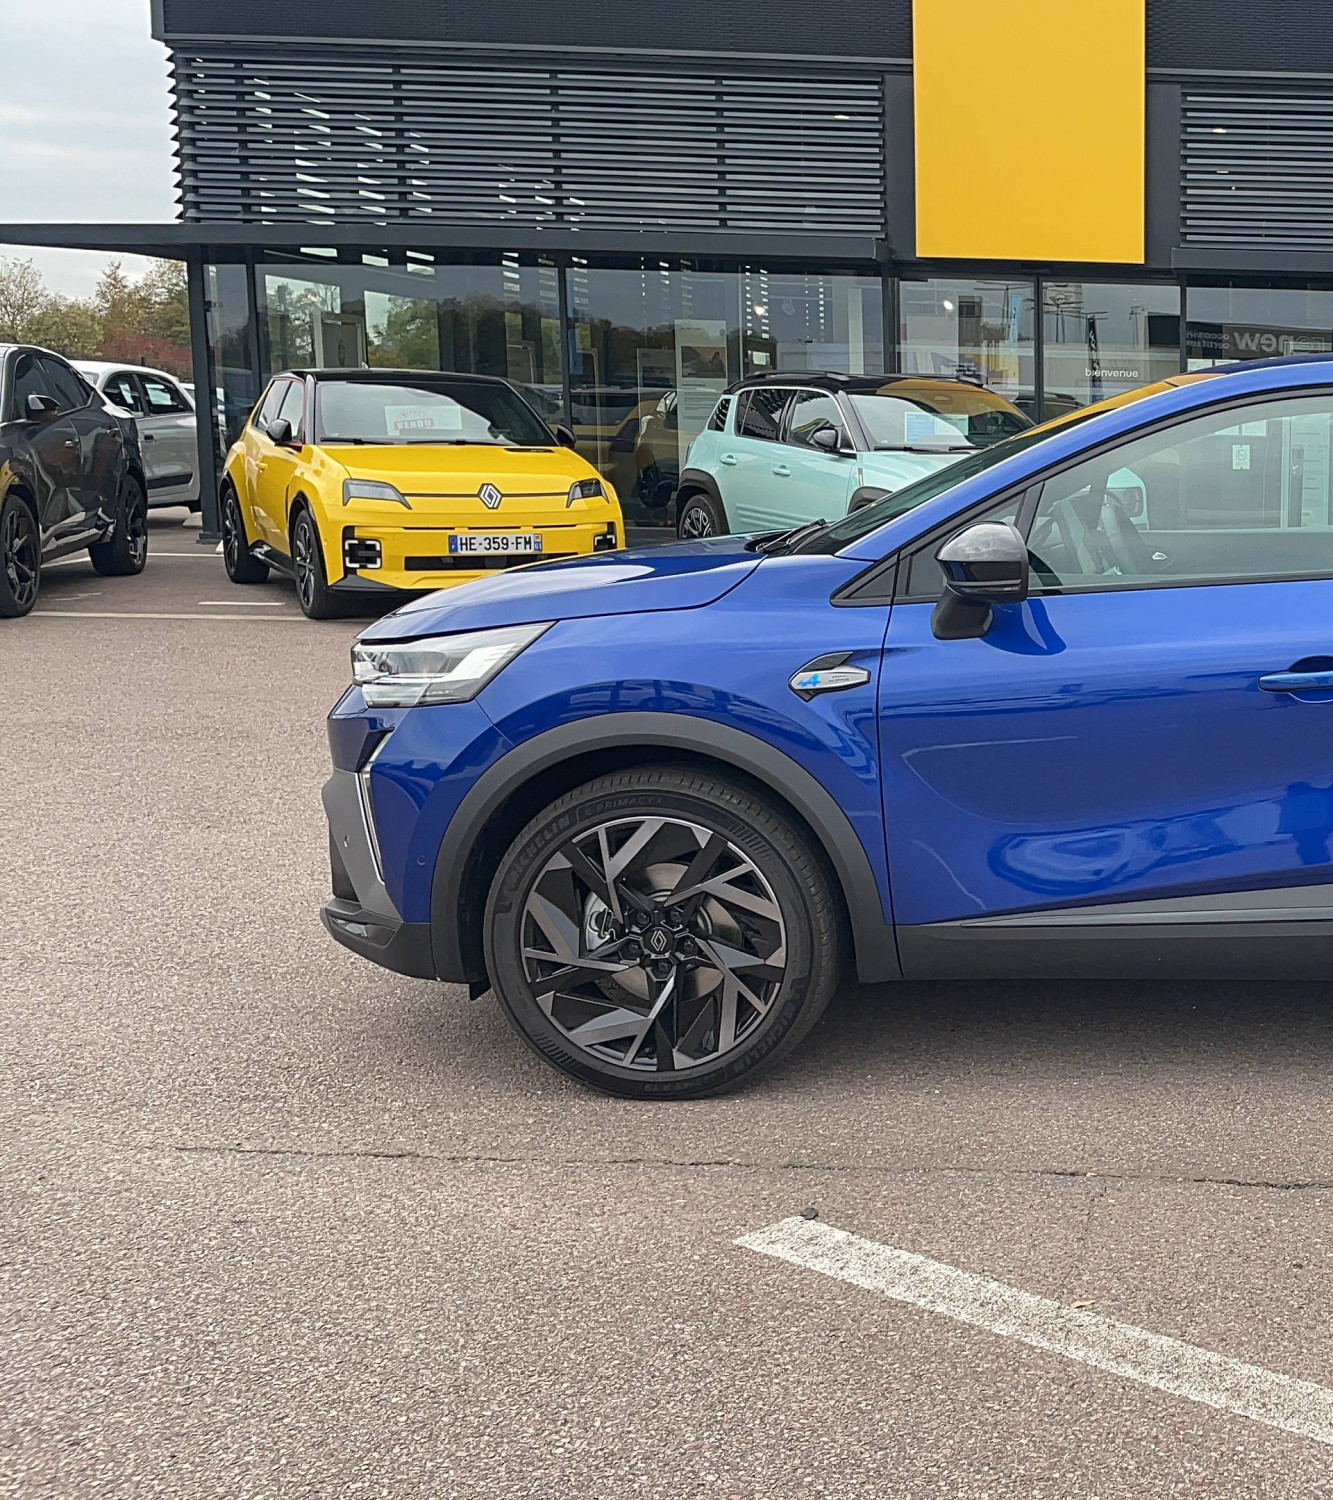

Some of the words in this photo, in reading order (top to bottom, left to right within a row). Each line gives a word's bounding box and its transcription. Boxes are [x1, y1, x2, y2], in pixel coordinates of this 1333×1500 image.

[1084, 367, 1139, 378] bienvenue
[459, 536, 532, 551] HE-359-FM
[596, 796, 656, 812] PRIMACY
